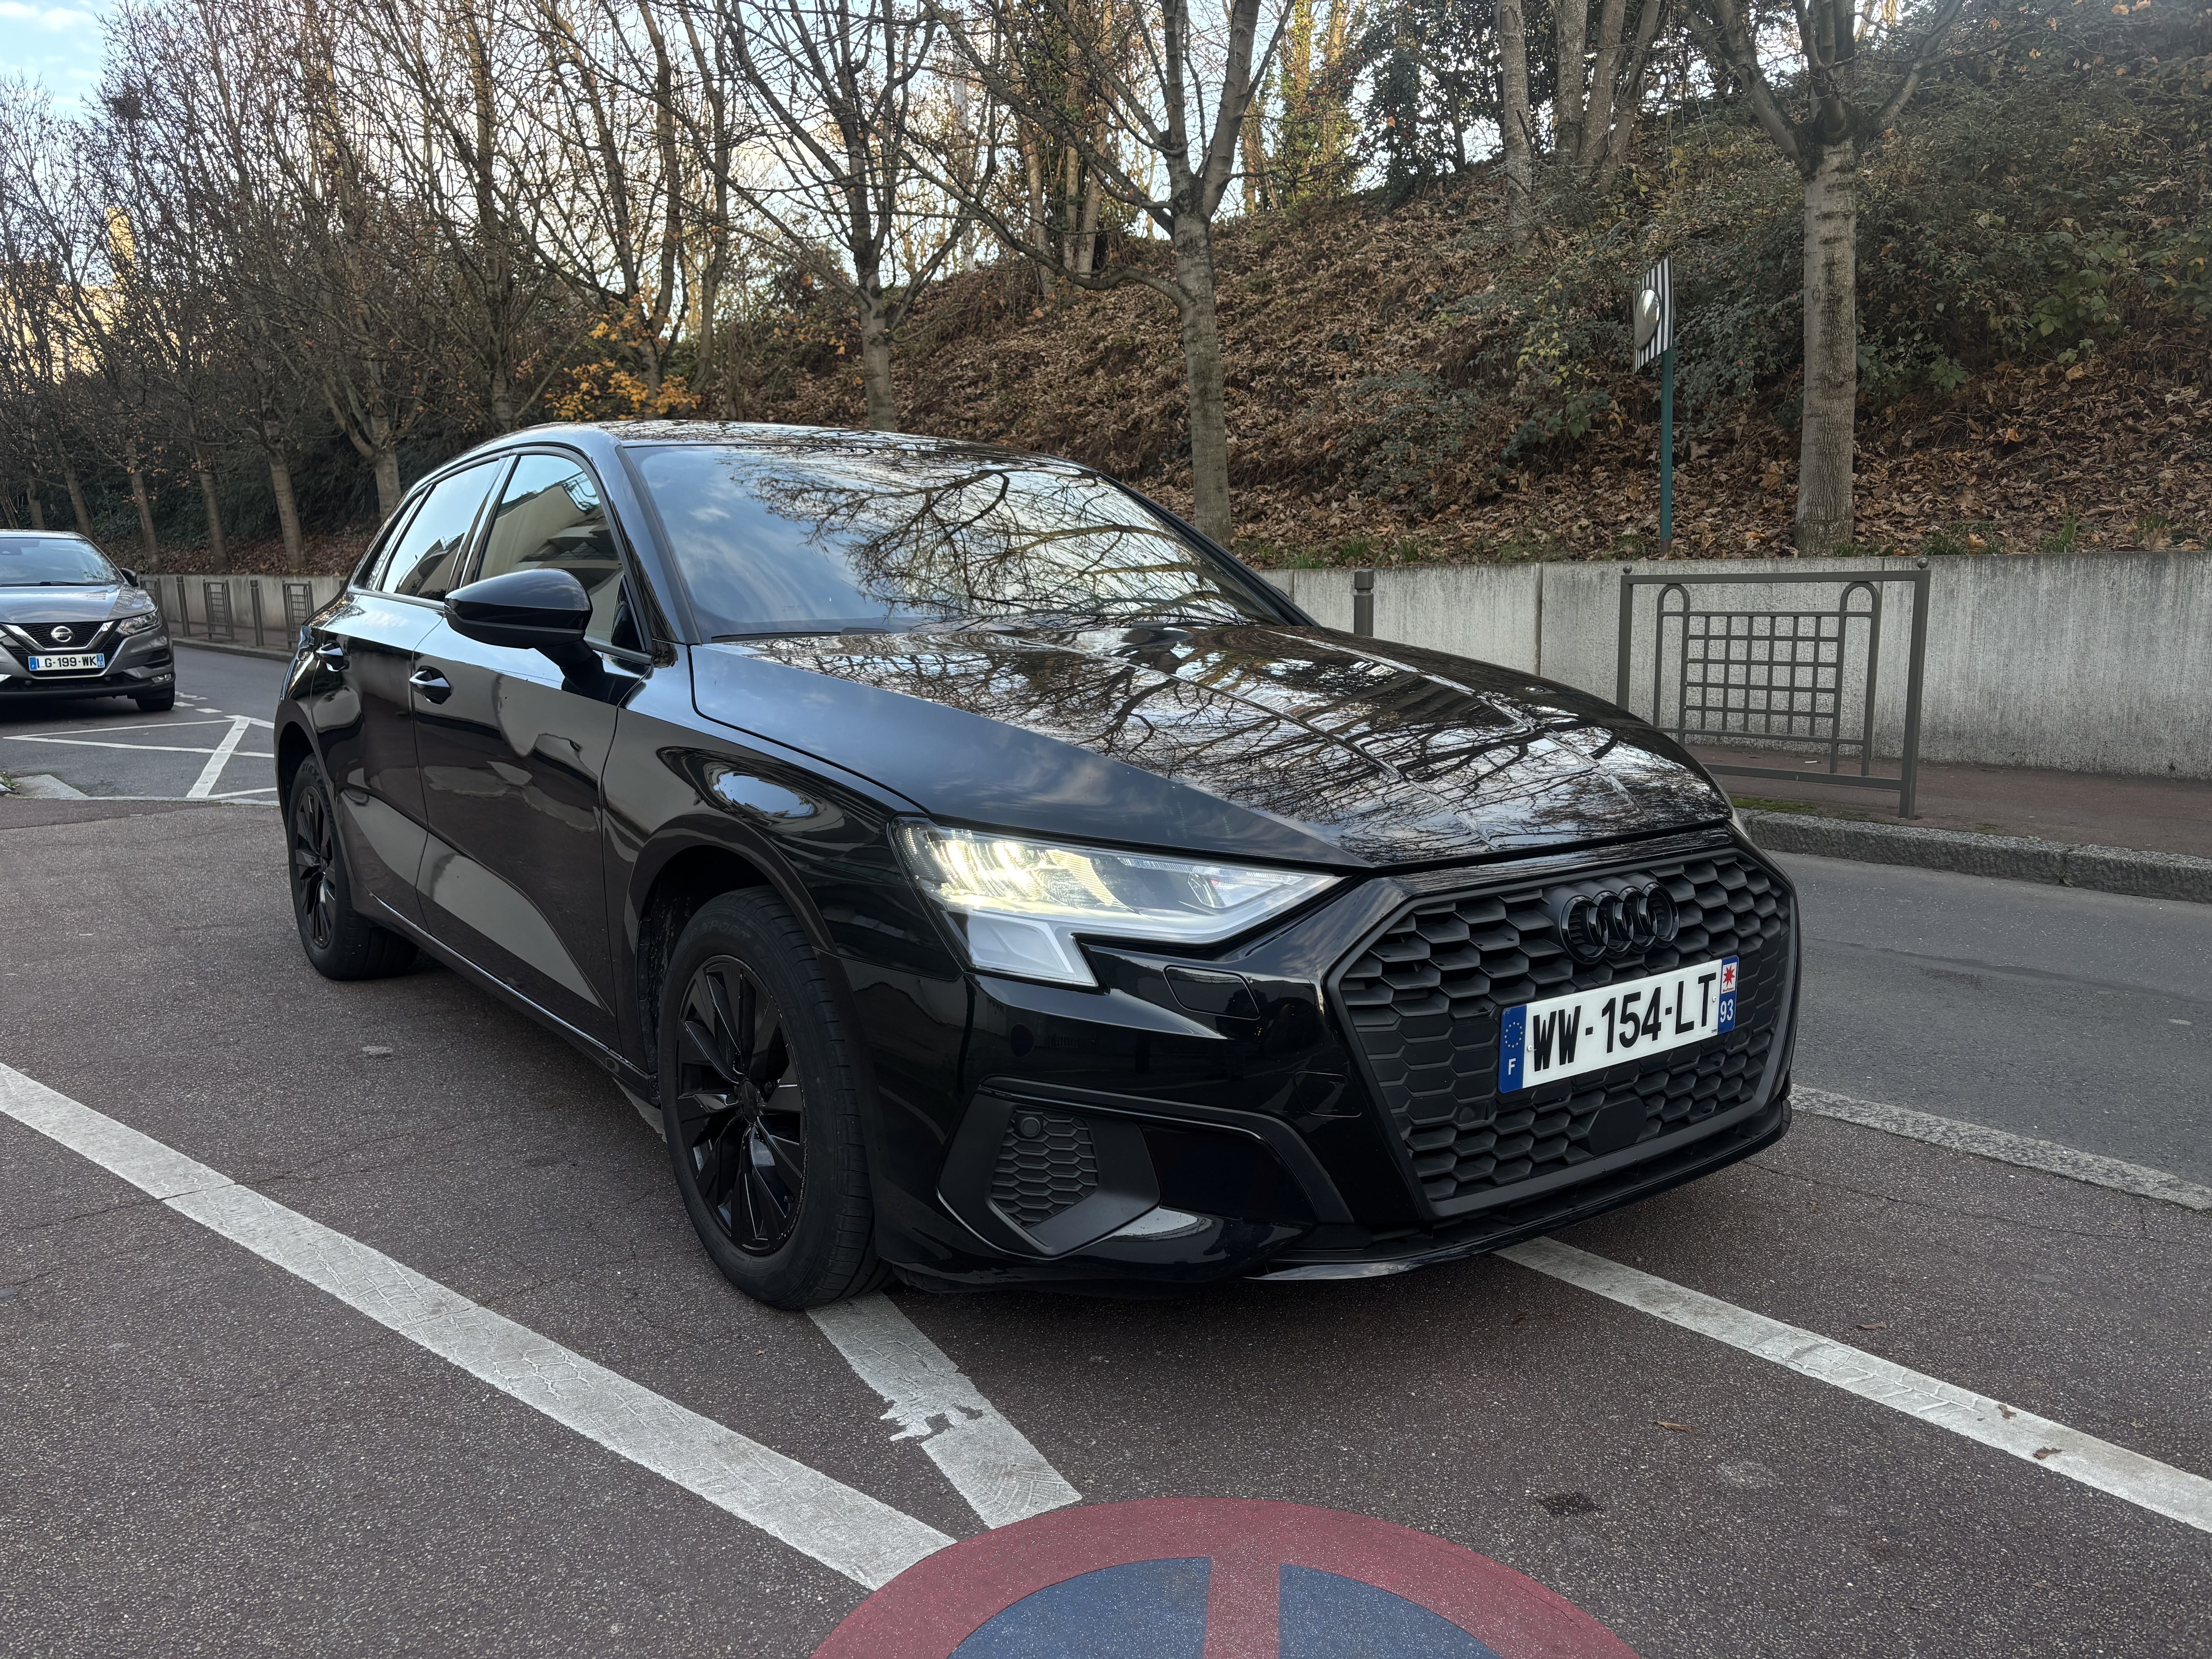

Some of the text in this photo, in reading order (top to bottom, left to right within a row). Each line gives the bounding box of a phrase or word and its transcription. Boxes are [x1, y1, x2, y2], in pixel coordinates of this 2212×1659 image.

[1533, 972, 1716, 1072] WW-154-LT
[1720, 999, 1734, 1023] 93
[1508, 1058, 1516, 1075] F
